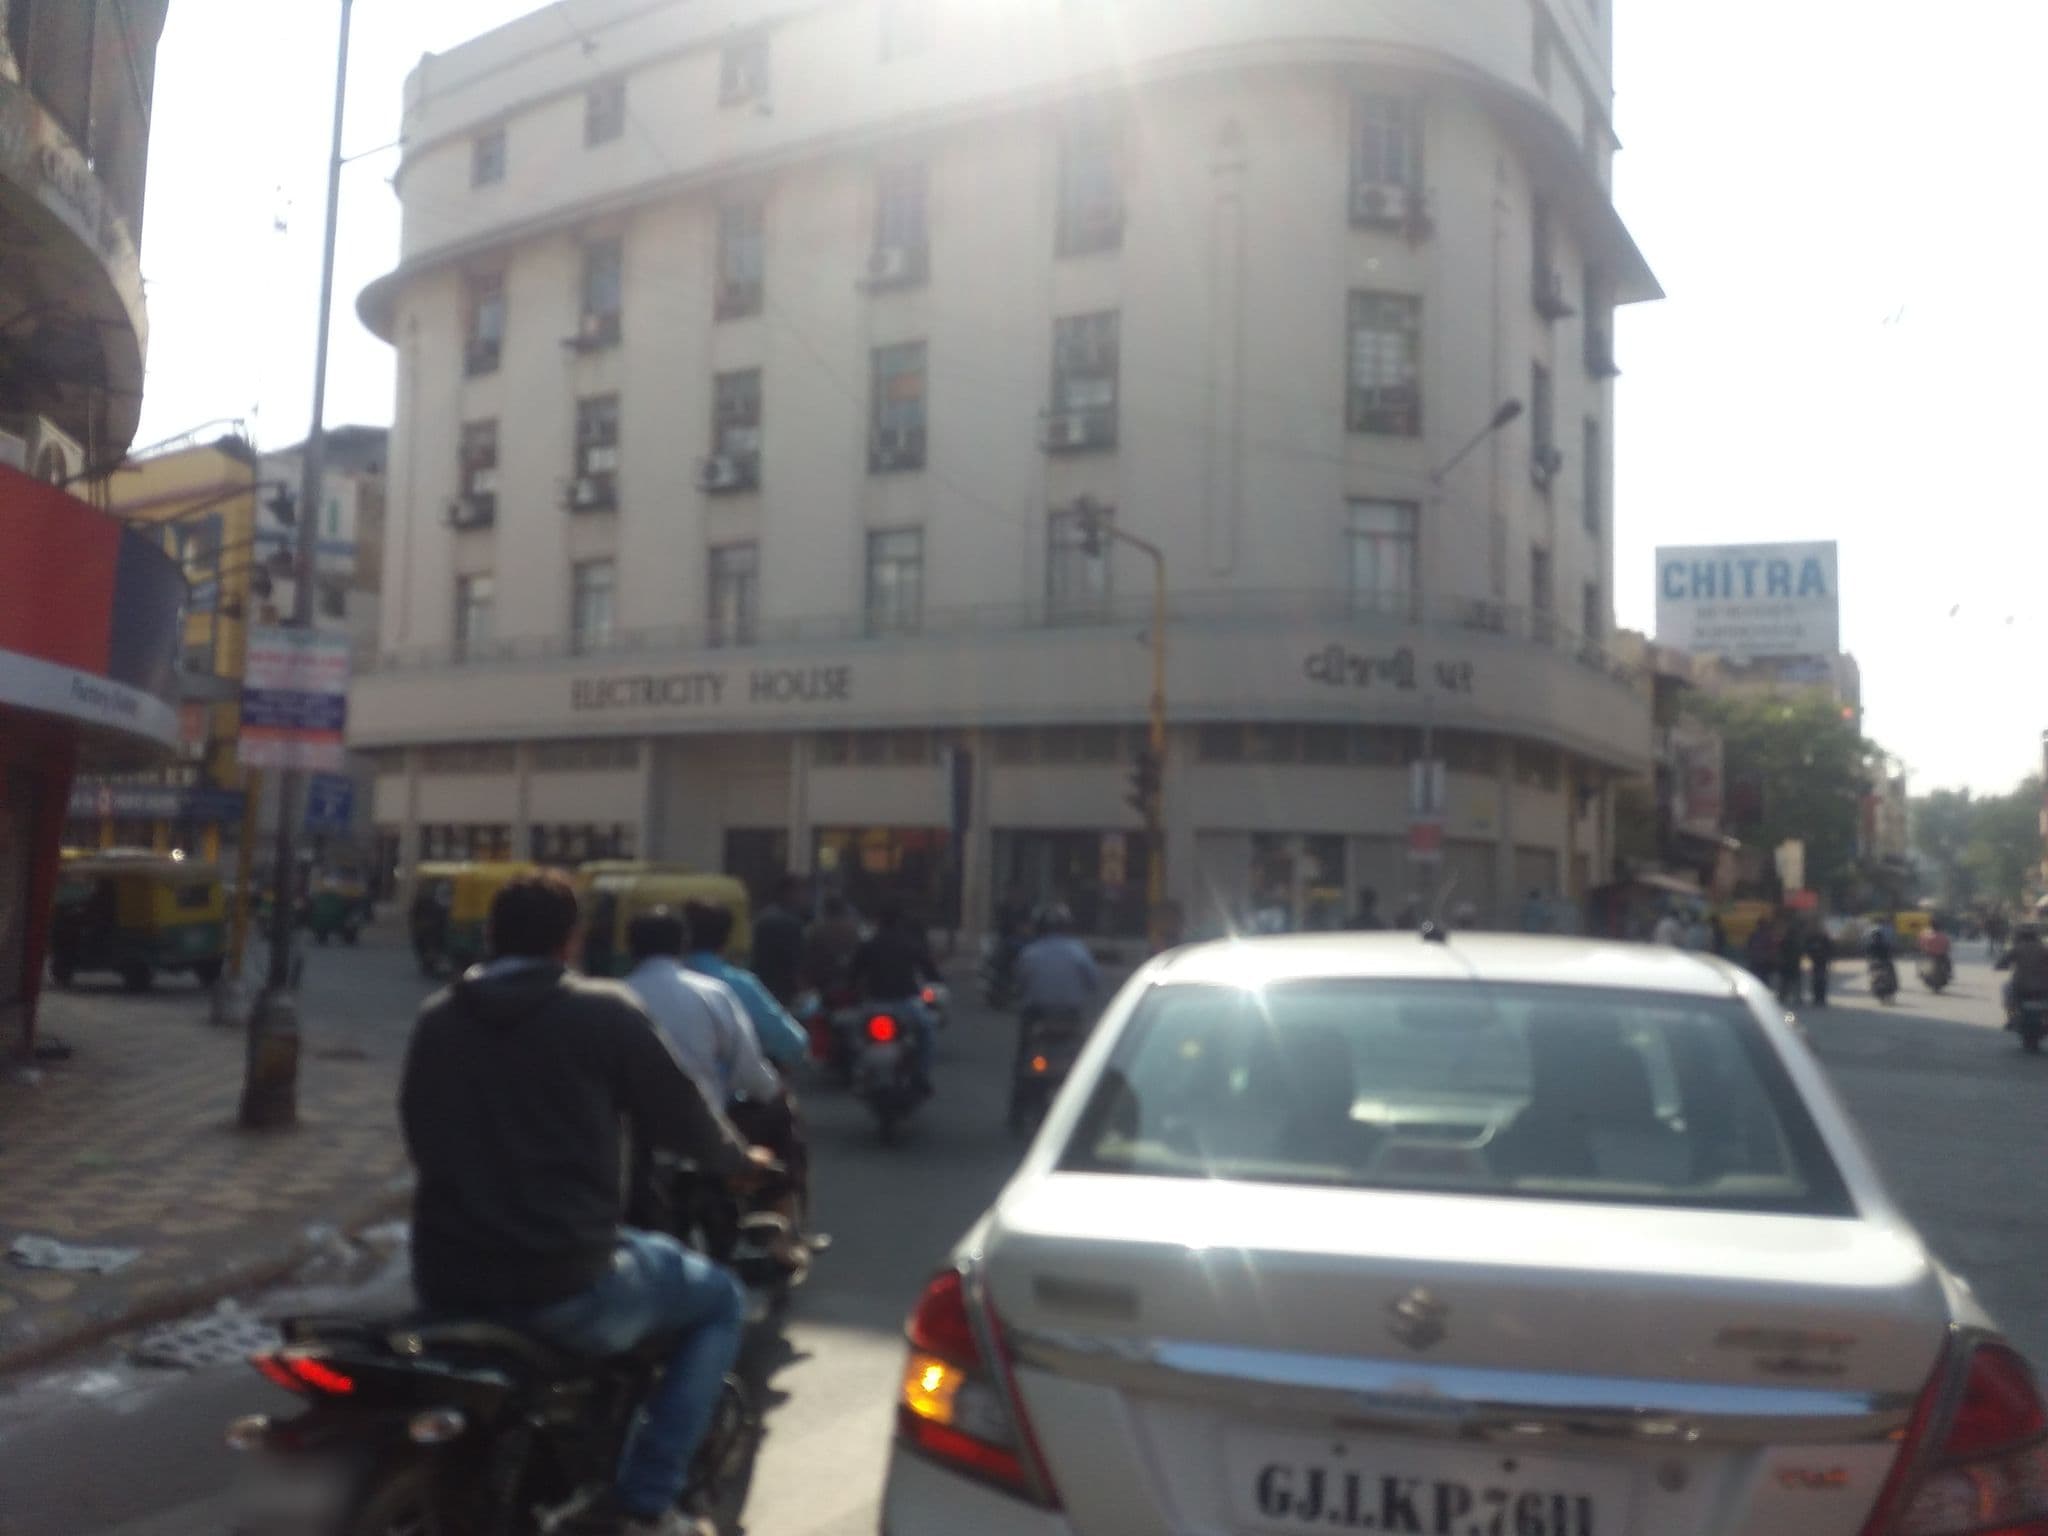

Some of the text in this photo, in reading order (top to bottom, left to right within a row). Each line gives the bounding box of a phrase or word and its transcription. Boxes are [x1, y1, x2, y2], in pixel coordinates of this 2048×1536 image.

[1662, 557, 1827, 599] CHITRA
[570, 664, 852, 711] ELECTRICITY HOUSE
